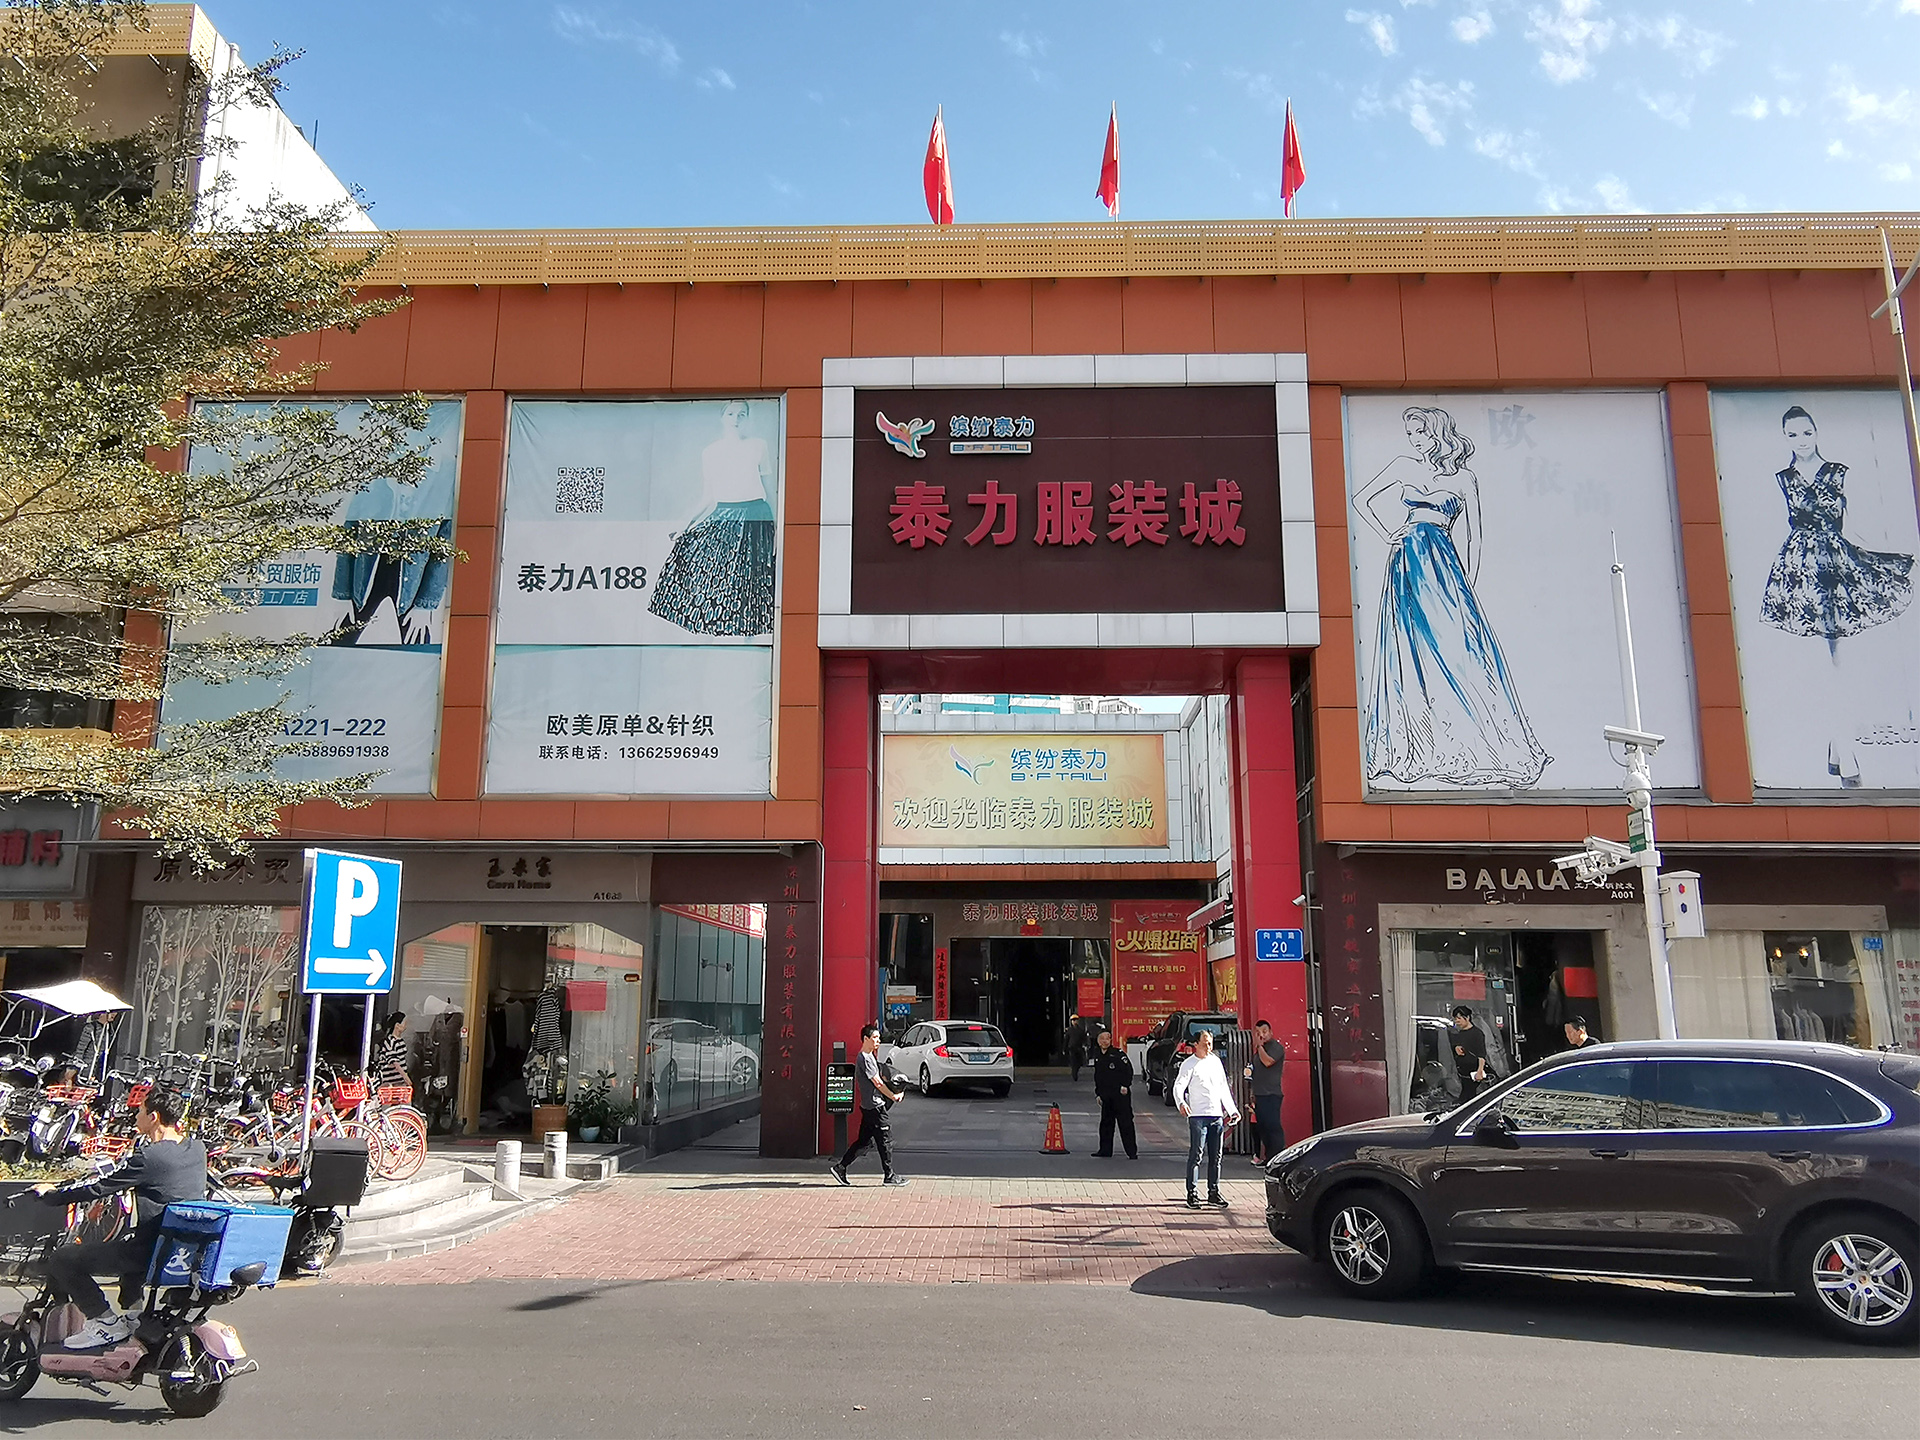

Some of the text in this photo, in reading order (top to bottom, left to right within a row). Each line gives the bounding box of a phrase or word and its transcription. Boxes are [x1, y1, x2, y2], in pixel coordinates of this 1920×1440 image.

[950, 415, 1035, 438] 缤纷泰力
[888, 478, 1246, 548] 泰力服装城
[517, 563, 648, 593] 泰力A188
[546, 713, 715, 737] 欧美原单&针织
[1010, 747, 1108, 770] 缤纷泰力
[1055, 772, 1108, 781] TAILI
[893, 795, 1155, 829] 欢迎光临泰力服装城
[333, 859, 379, 949] P
[1611, 891, 1634, 899] A001
[962, 903, 1099, 921] 泰力服装批发城
[1116, 930, 1200, 952] 火爆招商
[1271, 941, 1287, 953] 20
[779, 866, 800, 1080] 深圳市泰力服装有限公司
